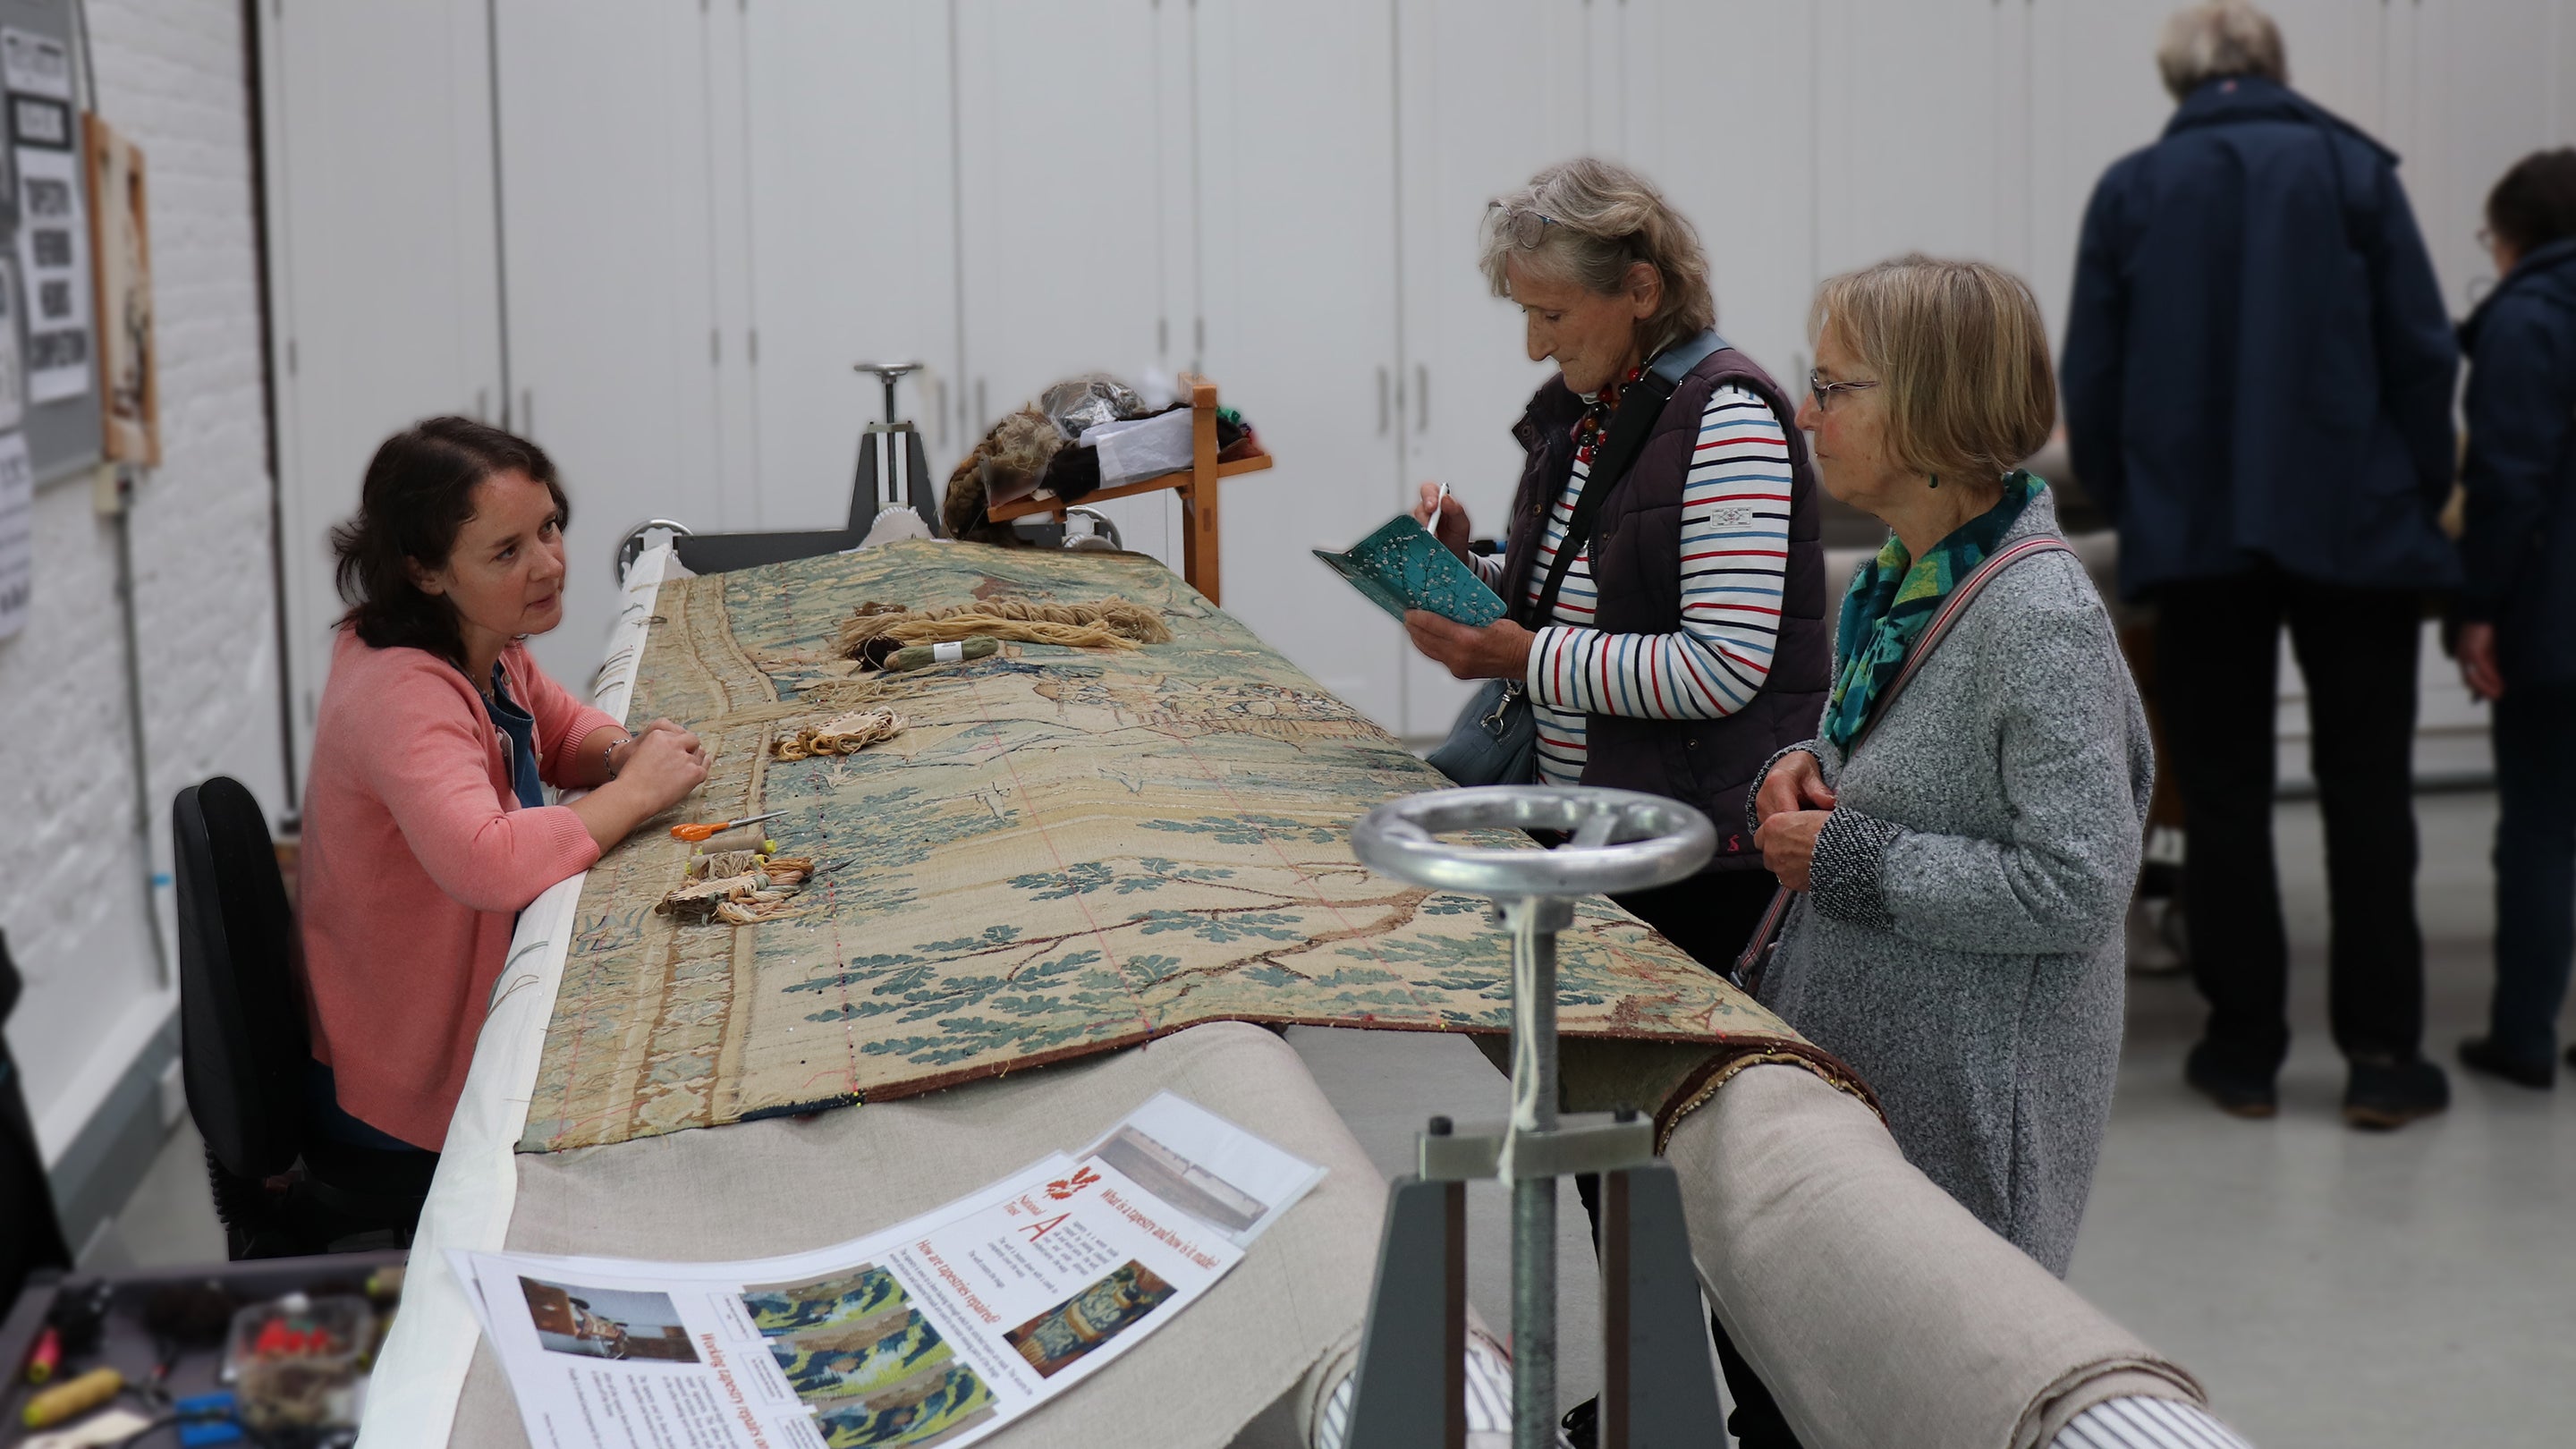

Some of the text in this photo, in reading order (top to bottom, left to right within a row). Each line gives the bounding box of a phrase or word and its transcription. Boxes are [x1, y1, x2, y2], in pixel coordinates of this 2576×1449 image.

[1020, 1194, 1047, 1216] National
[1100, 1188, 1123, 1207] What
[1115, 1199, 1128, 1211] is
[1003, 1200, 1021, 1216] Trust
[1122, 1207, 1132, 1215] a
[1018, 1212, 1072, 1242] A
[1126, 1209, 1157, 1233] tapestry
[1152, 1227, 1174, 1241] and
[1165, 1233, 1182, 1250] how
[1178, 1241, 1191, 1254] is
[1183, 1245, 1199, 1258] it
[916, 1239, 934, 1256] How
[928, 1254, 944, 1267] are
[937, 1264, 971, 1297] tapestries
[964, 1293, 1002, 1325] repaired?
[699, 1333, 726, 1368] Working
[717, 1369, 744, 1404] tapestry
[736, 1406, 763, 1437] repairs
